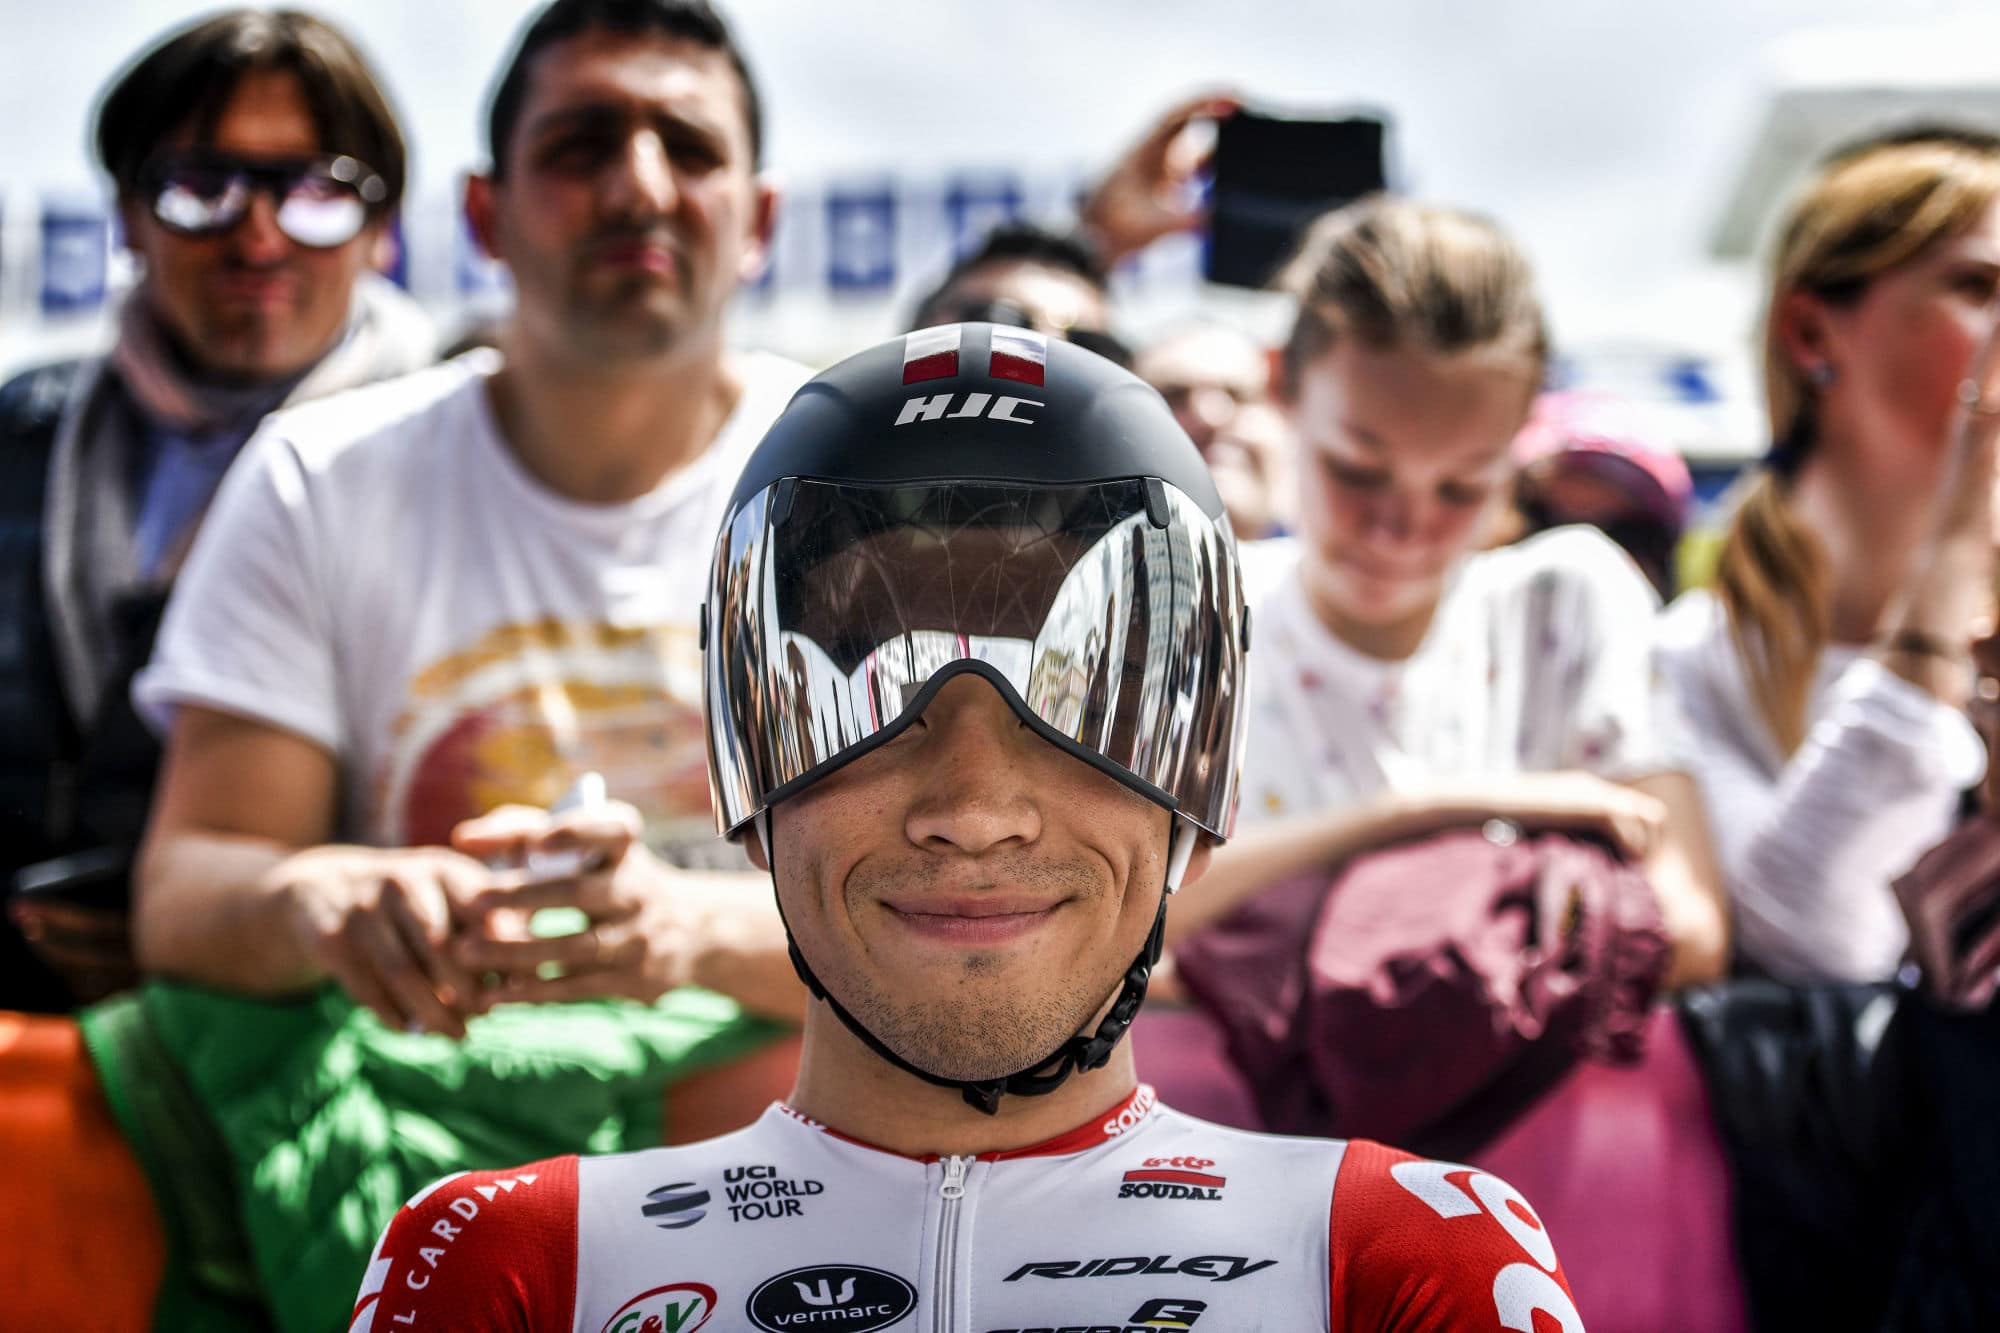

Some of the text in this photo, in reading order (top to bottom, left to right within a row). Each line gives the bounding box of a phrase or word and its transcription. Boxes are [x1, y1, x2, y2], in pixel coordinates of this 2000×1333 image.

[894, 392, 1045, 426] HJC
[723, 1166, 777, 1183] UCI
[725, 1180, 824, 1203] WORLD
[1118, 1183, 1222, 1200] SOUDAL
[728, 1199, 804, 1222] TOUR
[406, 1197, 480, 1290] CARD
[1002, 1255, 1279, 1282] RIDLEY
[775, 1303, 892, 1326] vermarc
